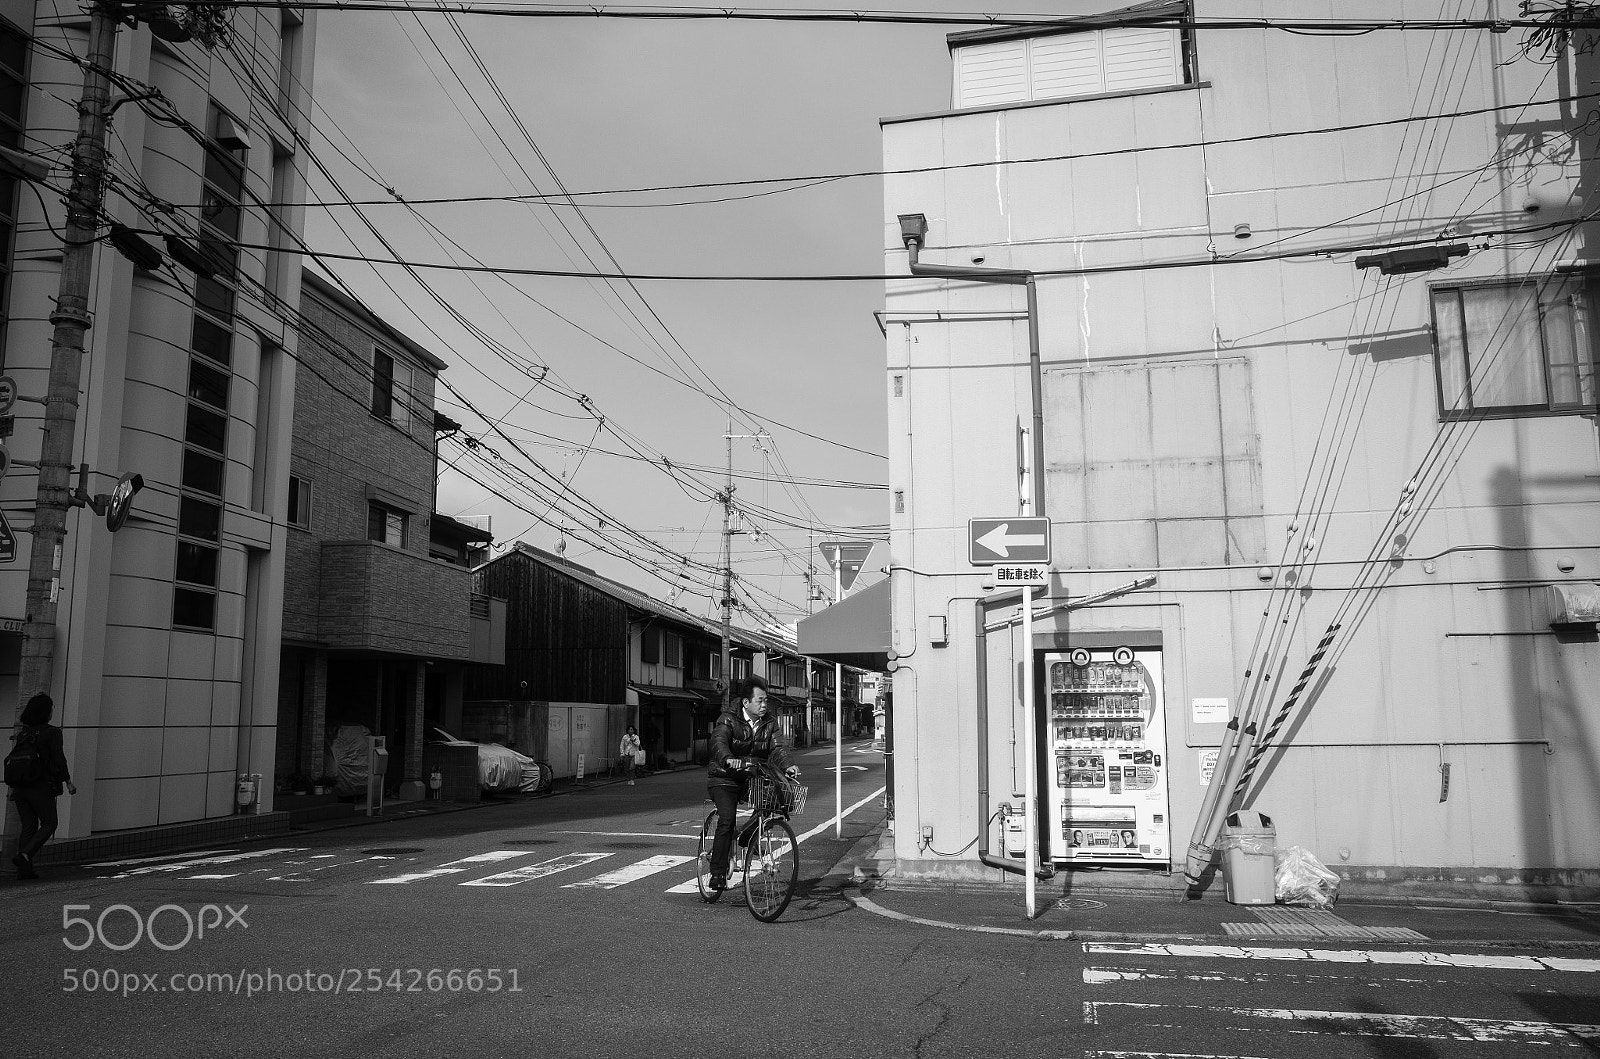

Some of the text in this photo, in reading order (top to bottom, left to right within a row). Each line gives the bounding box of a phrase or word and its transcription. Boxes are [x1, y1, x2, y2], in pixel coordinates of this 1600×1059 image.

[997, 567, 1044, 580] 自転車を除く
